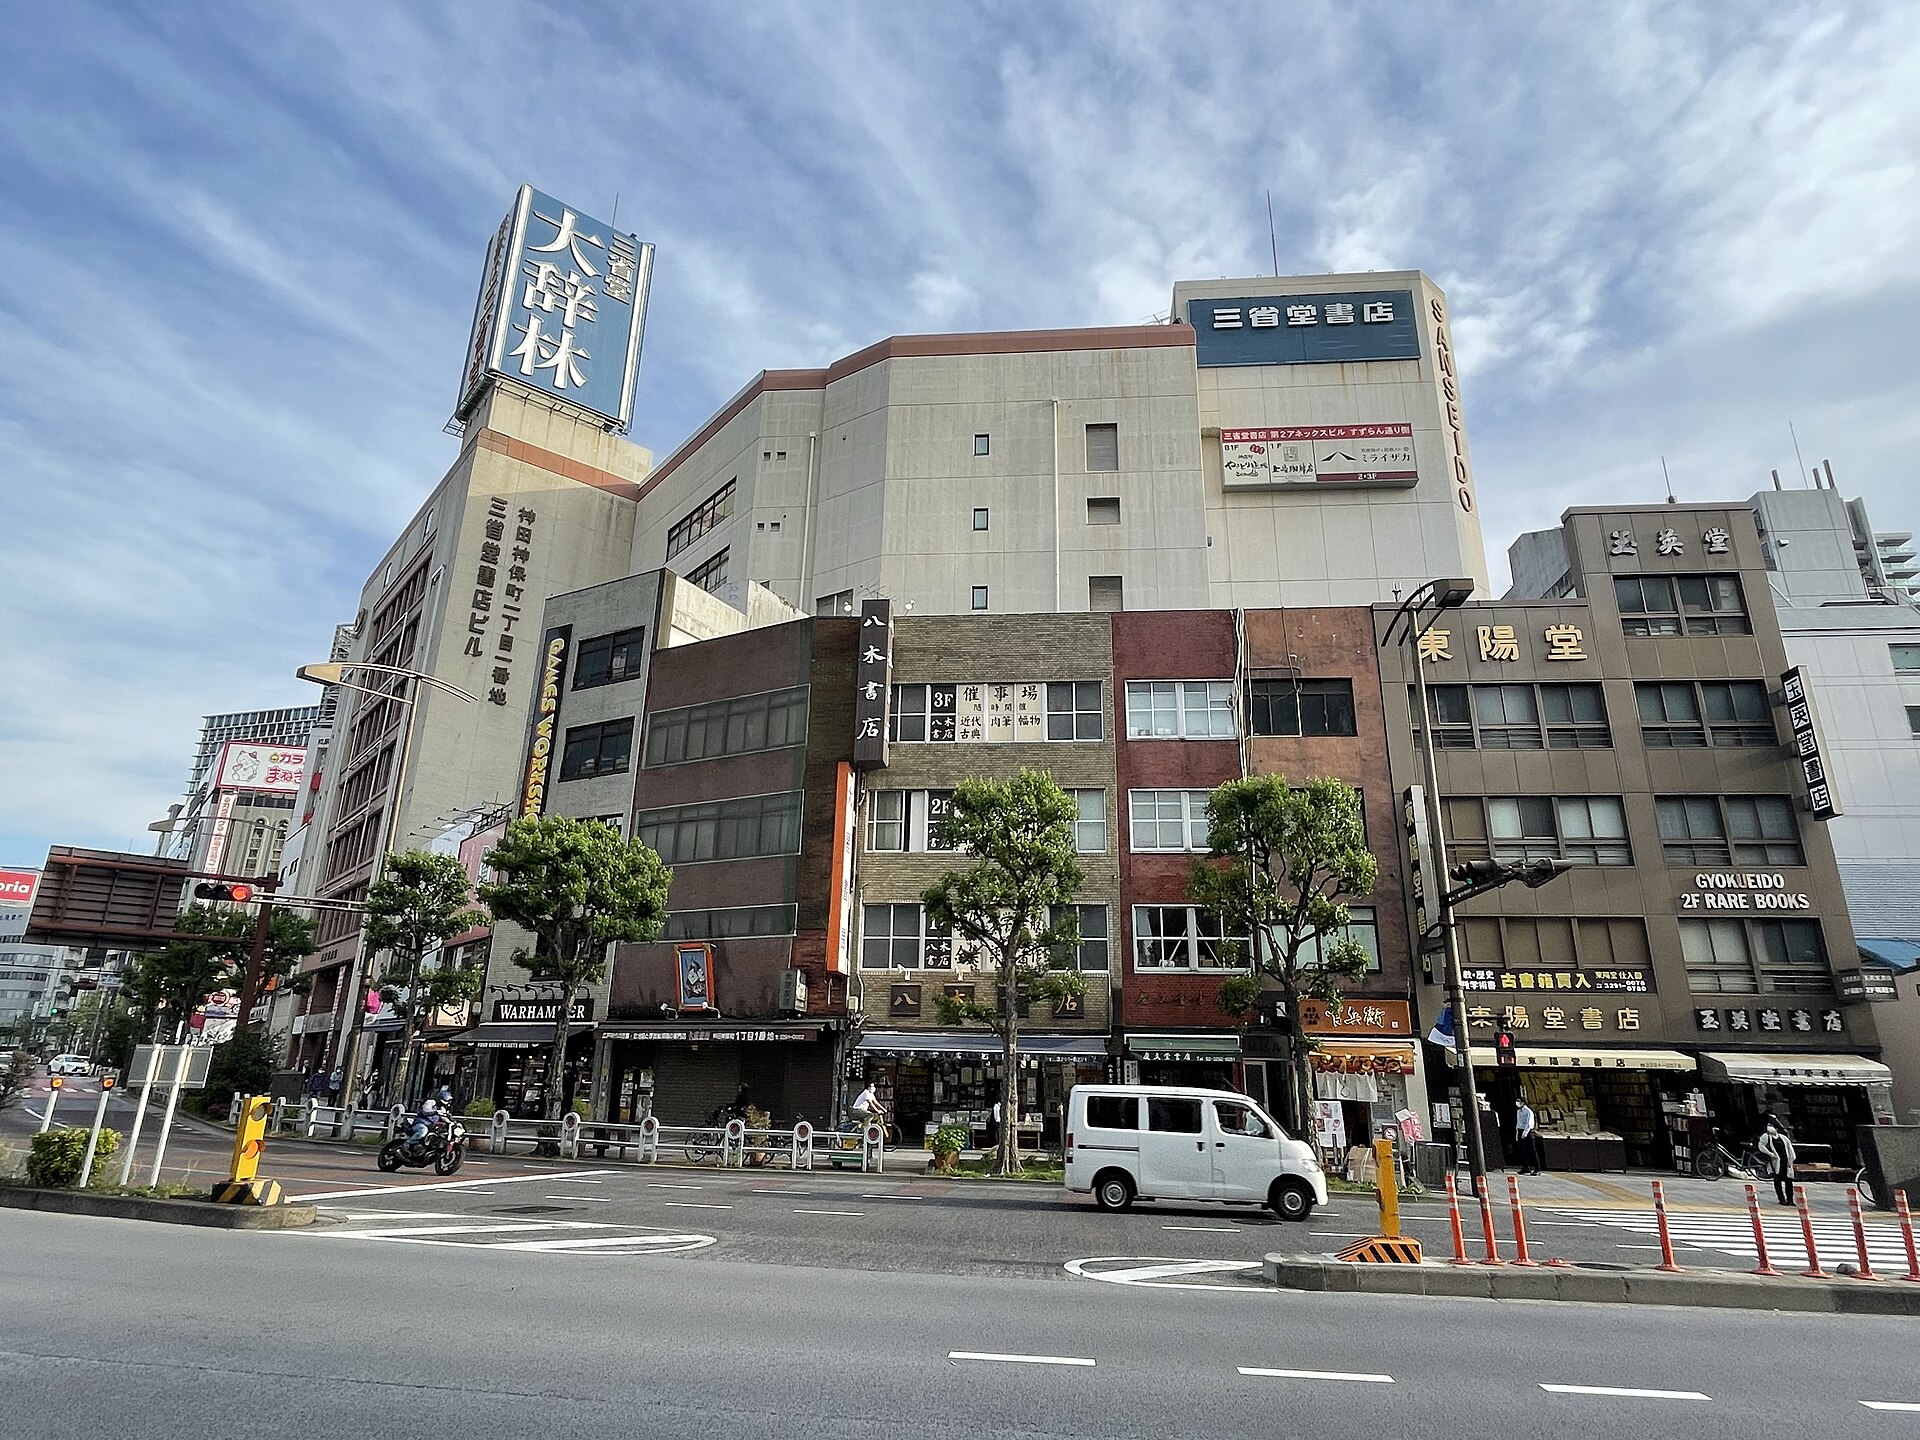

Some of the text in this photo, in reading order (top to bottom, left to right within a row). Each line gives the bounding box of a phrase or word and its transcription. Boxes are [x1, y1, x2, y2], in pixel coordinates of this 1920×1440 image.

[602, 232, 637, 305] 三省堂
[508, 208, 605, 390] 大辞林
[1212, 301, 1396, 329] 三省堂書店
[1431, 299, 1473, 513] SANSEIDO
[1223, 426, 1411, 440] 三省堂書店 第2アネックスビル すずらん通り側
[1362, 453, 1410, 463] ミライザカ
[1272, 462, 1314, 474] 上島珈琲店
[1610, 527, 1730, 556] 玉英堂
[464, 496, 508, 657] 三省堂書店ビル
[488, 506, 536, 706] 神田神保町一丁目一番地
[1419, 624, 1588, 662] 東陽堂
[856, 615, 887, 740] 八木書店
[933, 691, 954, 708] 3F
[963, 685, 1038, 702] 催事場
[931, 717, 955, 727] 八木
[960, 715, 1041, 727] 近代 肉筆 幅物
[524, 638, 565, 823] GAMES WORKSHO
[930, 728, 955, 740] 書店
[960, 728, 981, 740] 古典
[1784, 676, 1830, 811] 玉英堂書店
[1695, 873, 1785, 889] GYOKUEIDO
[1681, 893, 1810, 909] 2F RARE BOOKS
[925, 942, 951, 953] 八木
[925, 954, 951, 967] 書店
[1500, 972, 1592, 989] 古書籍買入
[500, 1005, 585, 1020] WARHAMER
[1700, 1009, 1842, 1032] 玉英堂書店
[1528, 1056, 1626, 1068] 東陽堂書店
